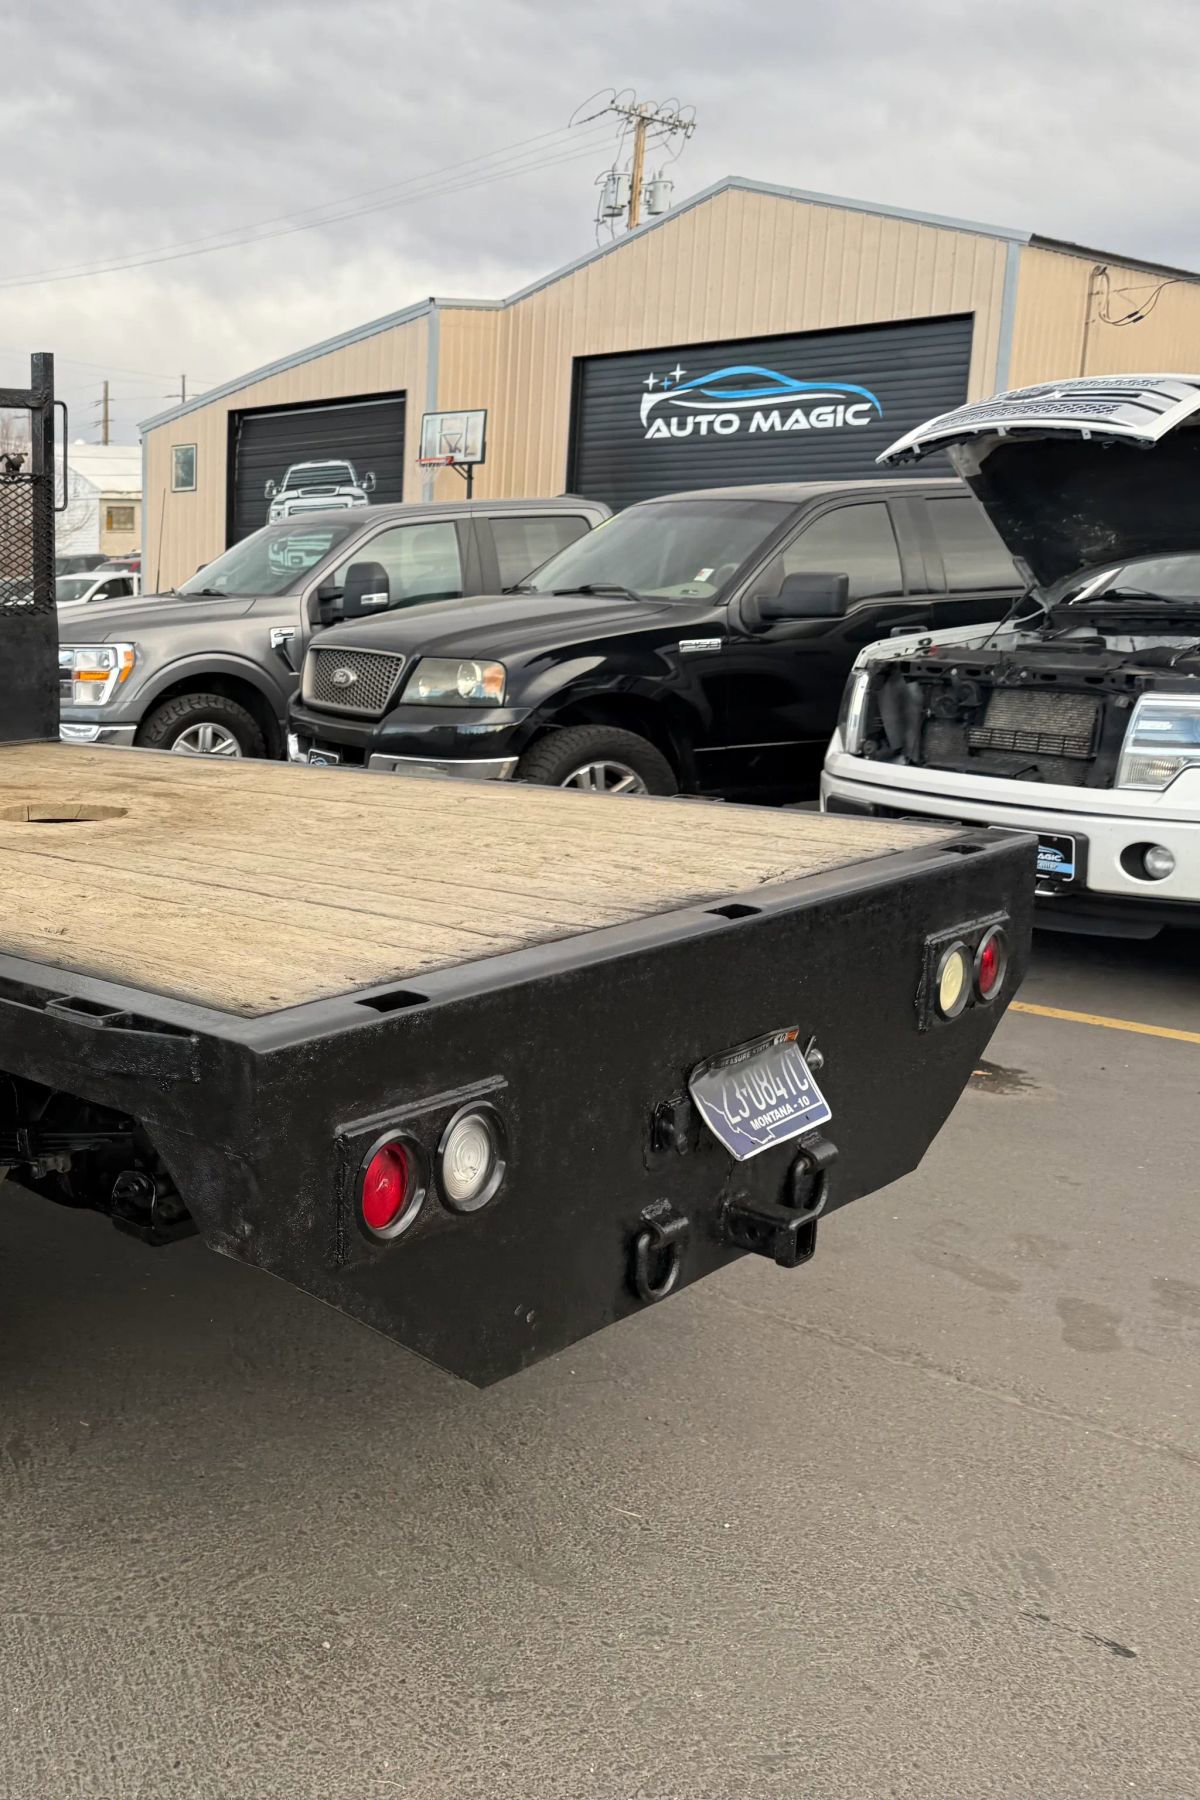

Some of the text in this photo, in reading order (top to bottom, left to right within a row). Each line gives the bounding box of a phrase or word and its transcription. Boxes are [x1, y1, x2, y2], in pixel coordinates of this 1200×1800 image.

[644, 402, 873, 439] AUTO MAGIC
[1037, 853, 1062, 862] AGIC
[749, 1103, 794, 1131] MONTANA
[798, 1095, 810, 1108] 10
